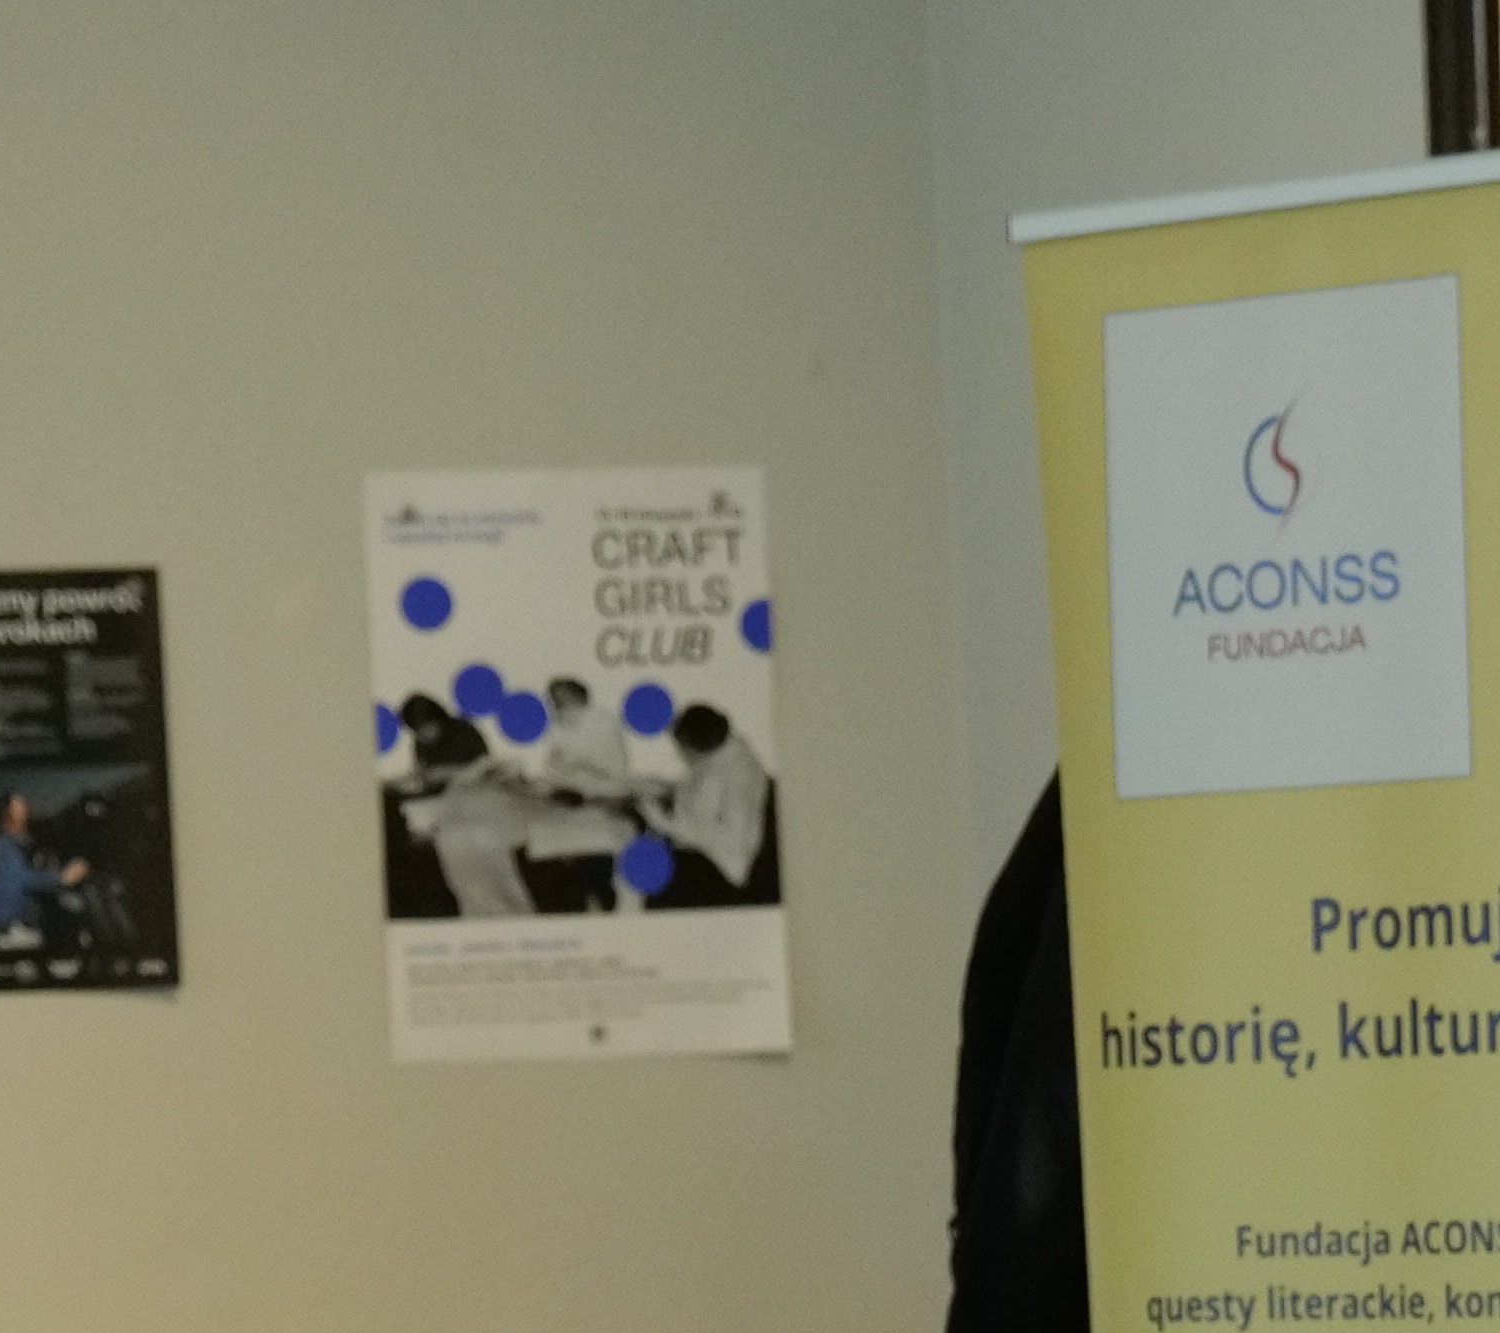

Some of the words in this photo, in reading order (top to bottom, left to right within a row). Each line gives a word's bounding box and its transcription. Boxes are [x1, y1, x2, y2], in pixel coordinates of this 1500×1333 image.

[592, 528, 741, 568] CRAFT
[595, 575, 730, 618] GIRLS
[1173, 550, 1400, 616] ACONSS
[596, 625, 713, 667] CLUB
[1207, 625, 1367, 661] FUNDACJA
[1101, 1006, 1318, 1076] historię,
[1236, 1223, 1391, 1264] Fundacja
[1147, 1290, 1256, 1331] questy
[1267, 1285, 1435, 1325] literackie,
